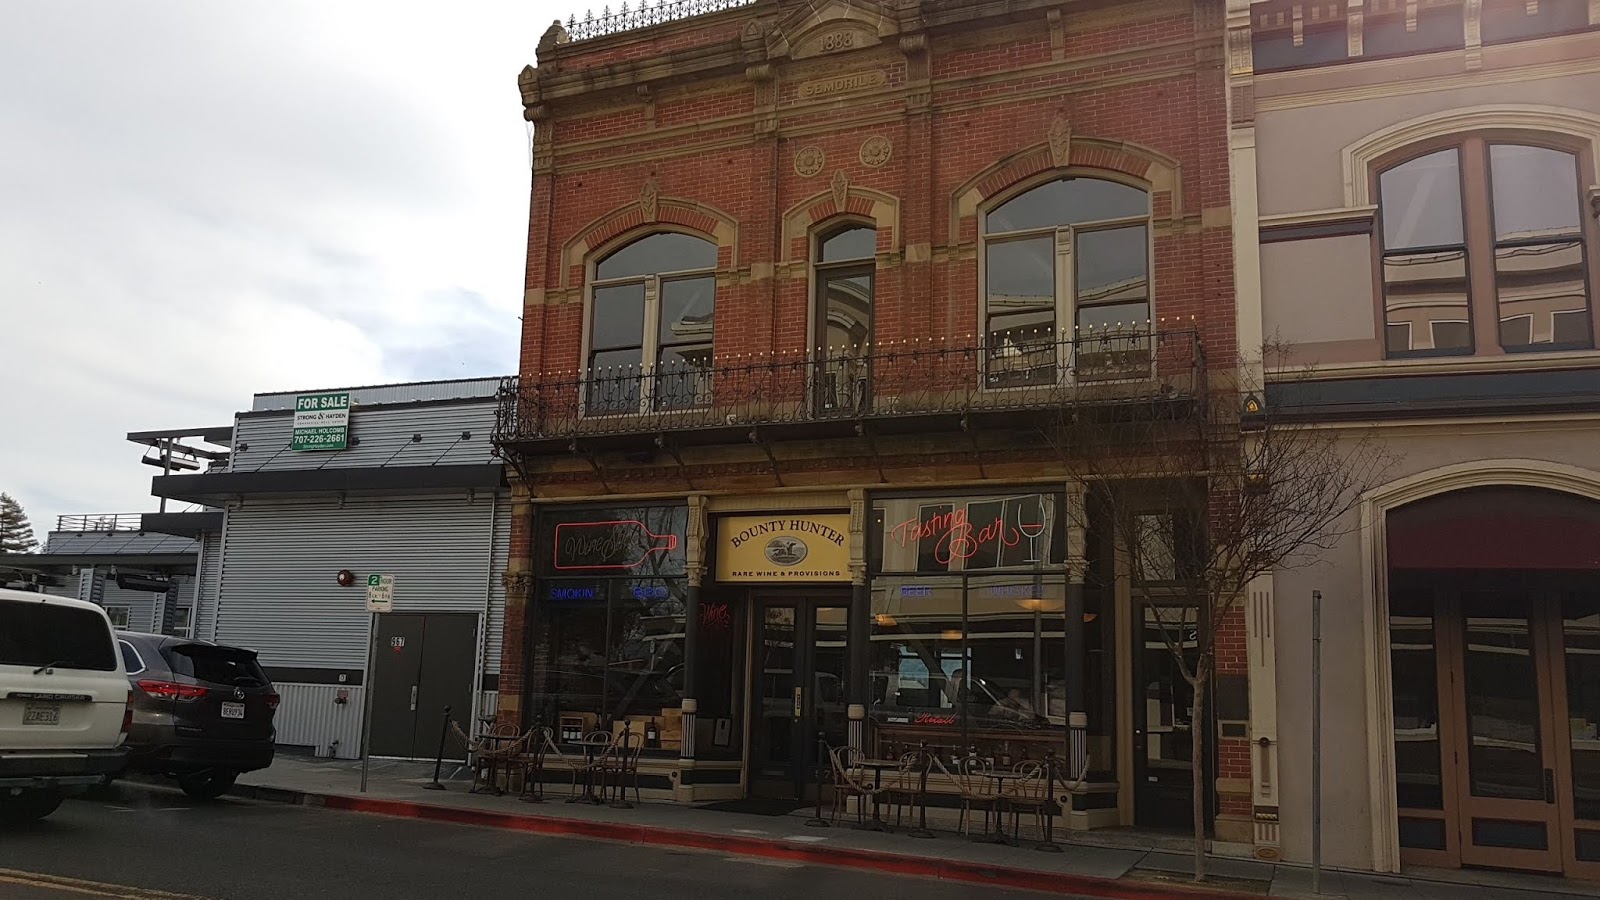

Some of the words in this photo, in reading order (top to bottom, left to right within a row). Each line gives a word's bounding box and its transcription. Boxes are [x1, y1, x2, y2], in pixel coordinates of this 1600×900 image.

[820, 31, 854, 52] 1888
[804, 74, 878, 95] SEMORILE
[298, 398, 318, 409] FOR
[321, 396, 347, 408] SALE
[294, 434, 344, 443] 707-226-2661
[730, 520, 786, 548] BOUNTY
[790, 520, 845, 546] HUNTER
[891, 508, 966, 547] Tasting
[935, 517, 1020, 564] Bar
[371, 576, 378, 584] 2
[901, 586, 932, 597] BEER
[914, 712, 957, 724] Retail
